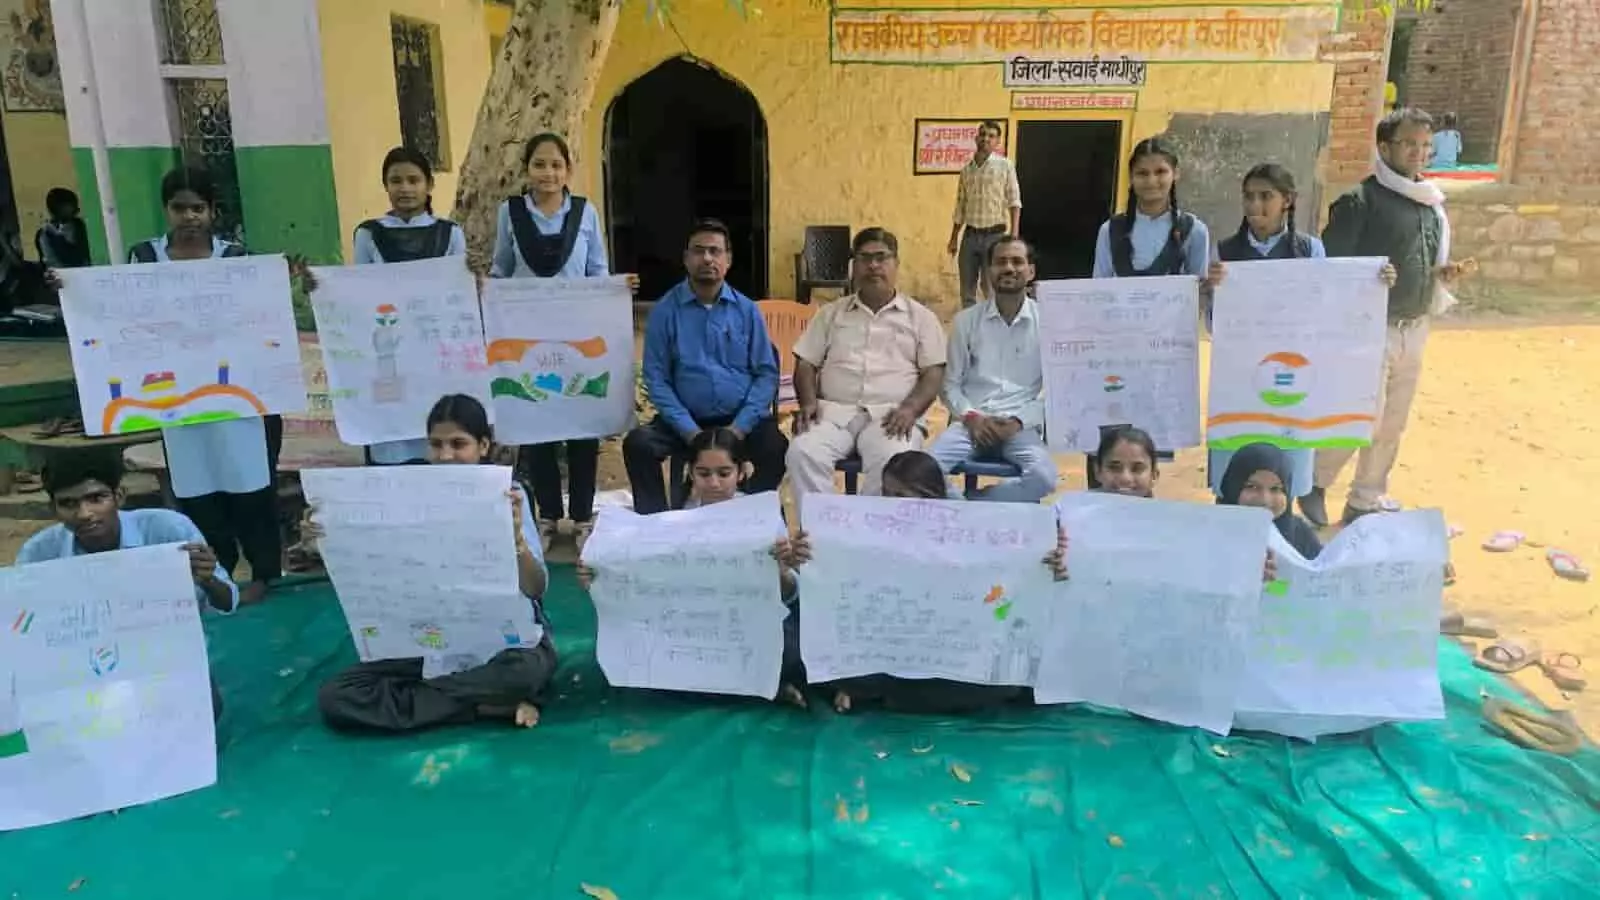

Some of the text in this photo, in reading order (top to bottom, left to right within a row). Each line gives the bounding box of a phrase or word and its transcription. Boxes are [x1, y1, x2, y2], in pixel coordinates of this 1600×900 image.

[835, 9, 1281, 58] राजकीय उच्च माध्यमिक विद्यालय वजीरपुर
